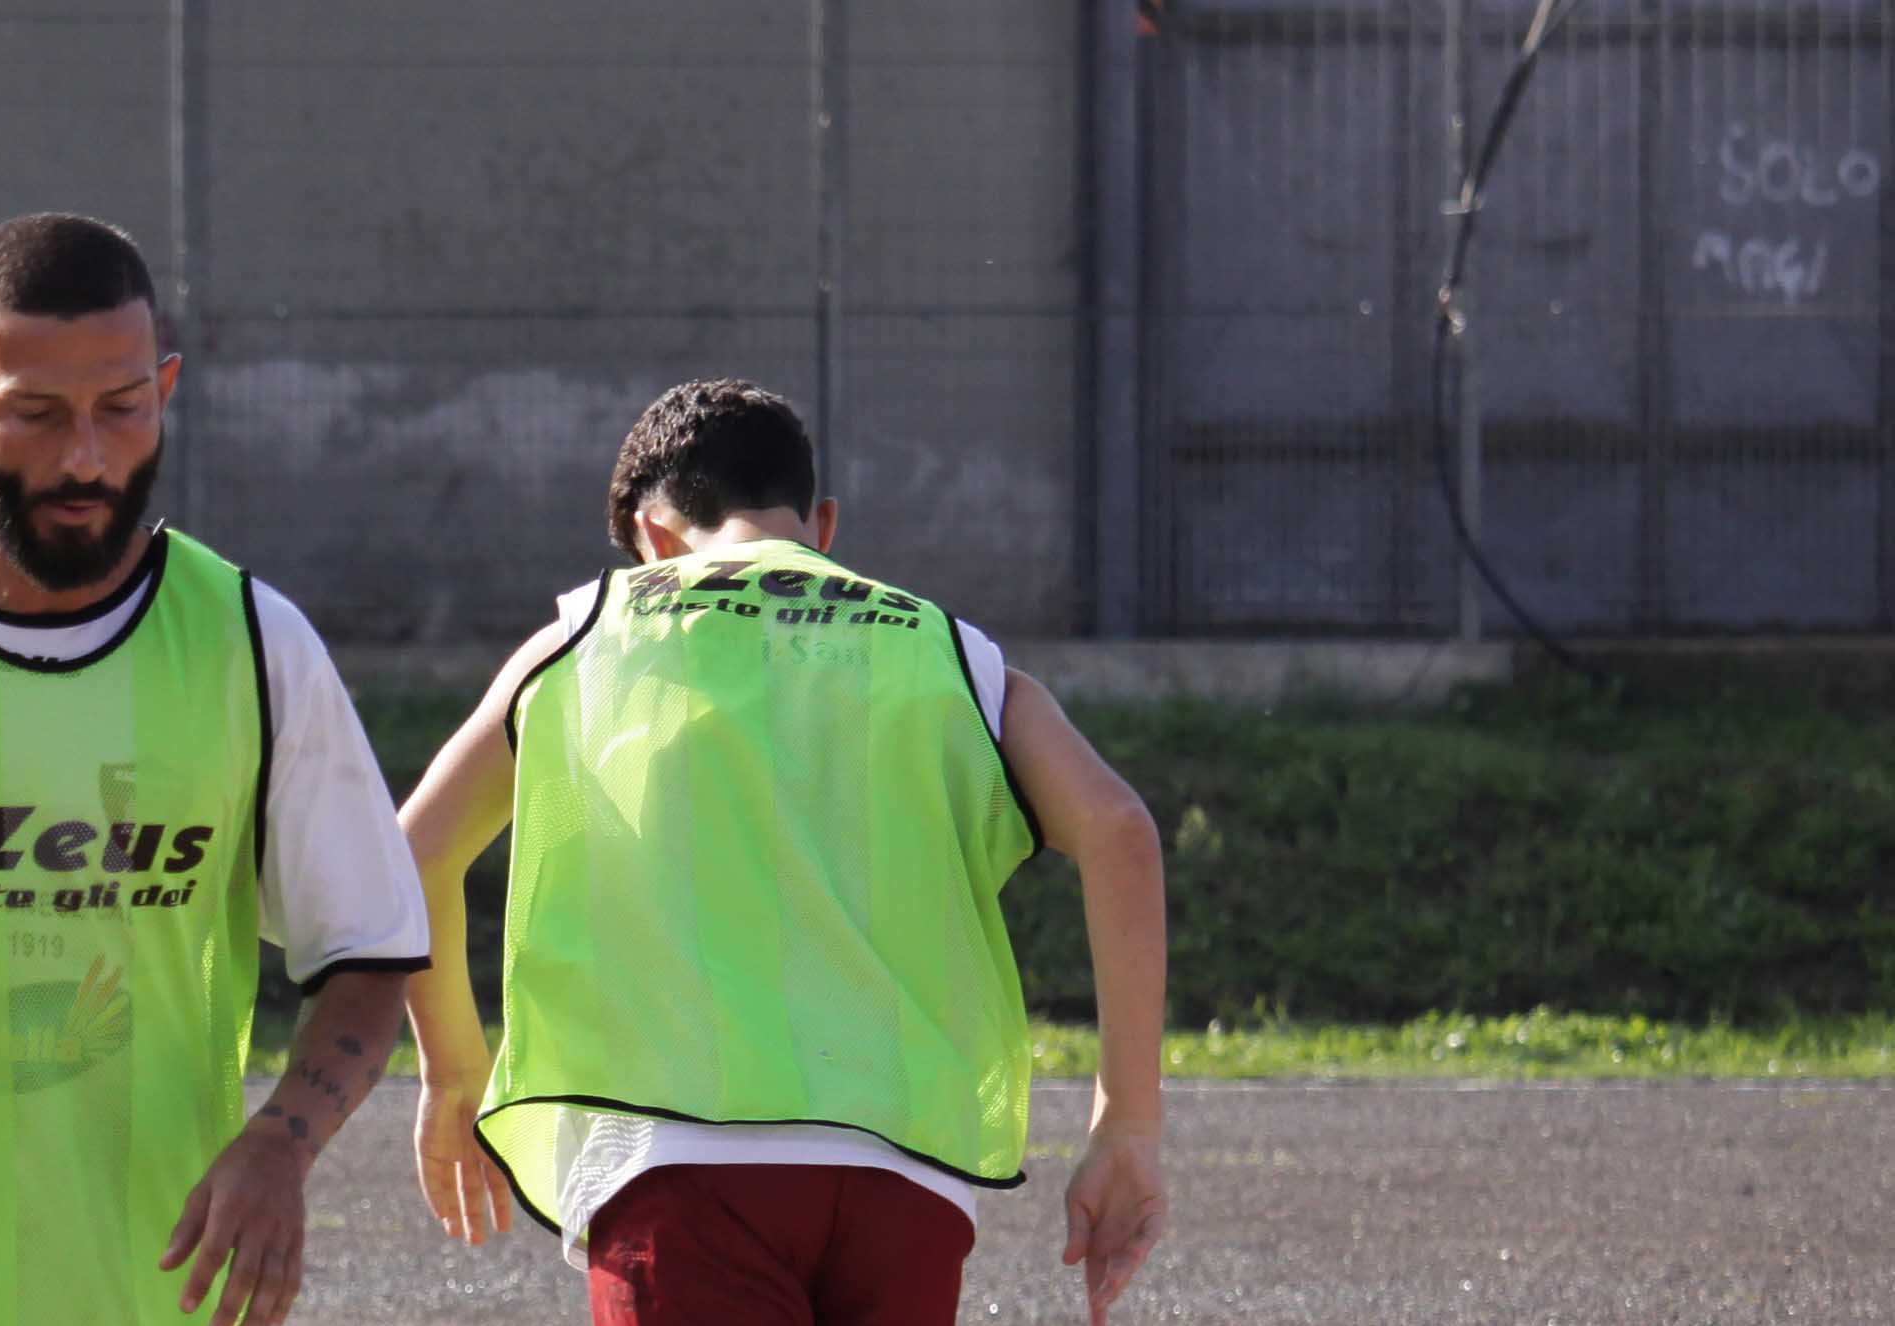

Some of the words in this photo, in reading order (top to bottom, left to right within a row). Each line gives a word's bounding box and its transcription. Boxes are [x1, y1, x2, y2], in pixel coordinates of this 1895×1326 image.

[1718, 120, 1880, 206] SOLO
[690, 560, 922, 612] Zeus
[776, 604, 838, 625] gli
[848, 609, 921, 630] dei
[53, 880, 121, 913] gli
[131, 880, 198, 909] dei
